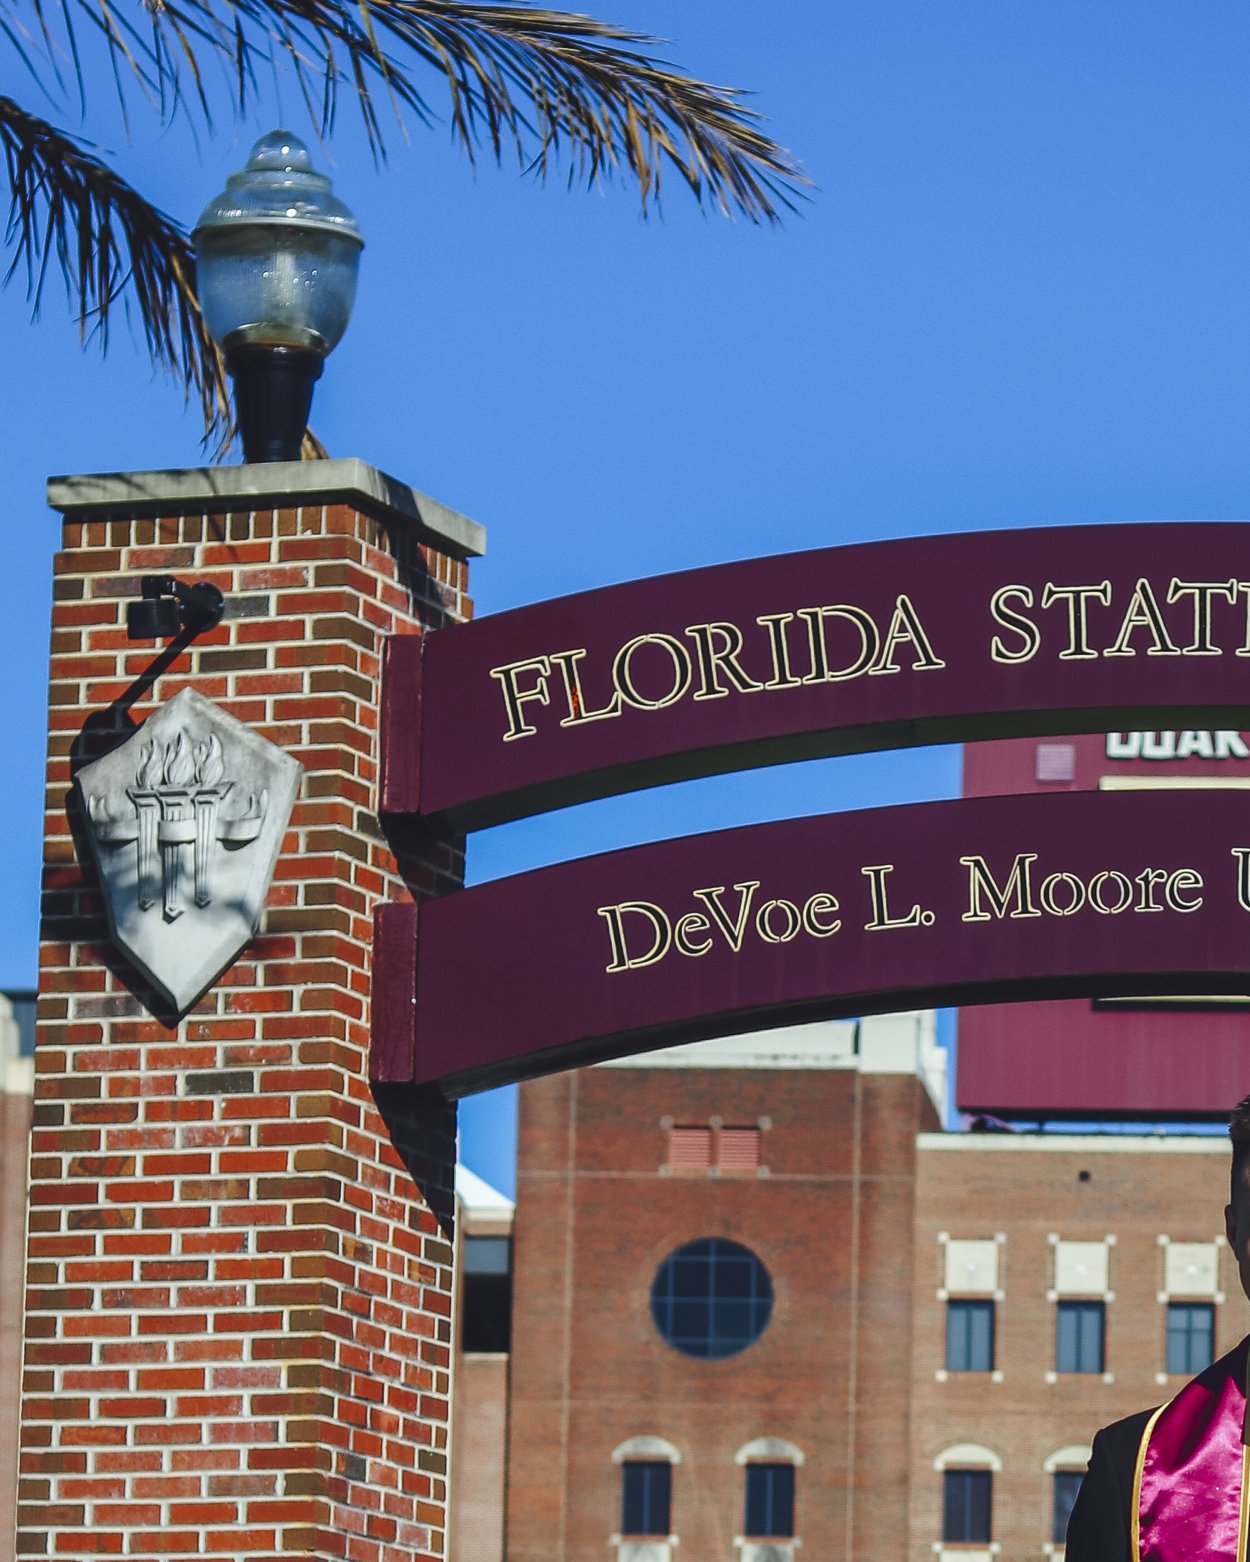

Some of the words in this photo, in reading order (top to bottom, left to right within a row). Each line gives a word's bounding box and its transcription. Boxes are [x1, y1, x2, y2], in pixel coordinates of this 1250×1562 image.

[489, 594, 946, 742] FLORIDA
[597, 880, 842, 973] DeVoe
[862, 864, 936, 931] L.
[960, 853, 1204, 922] Moore
